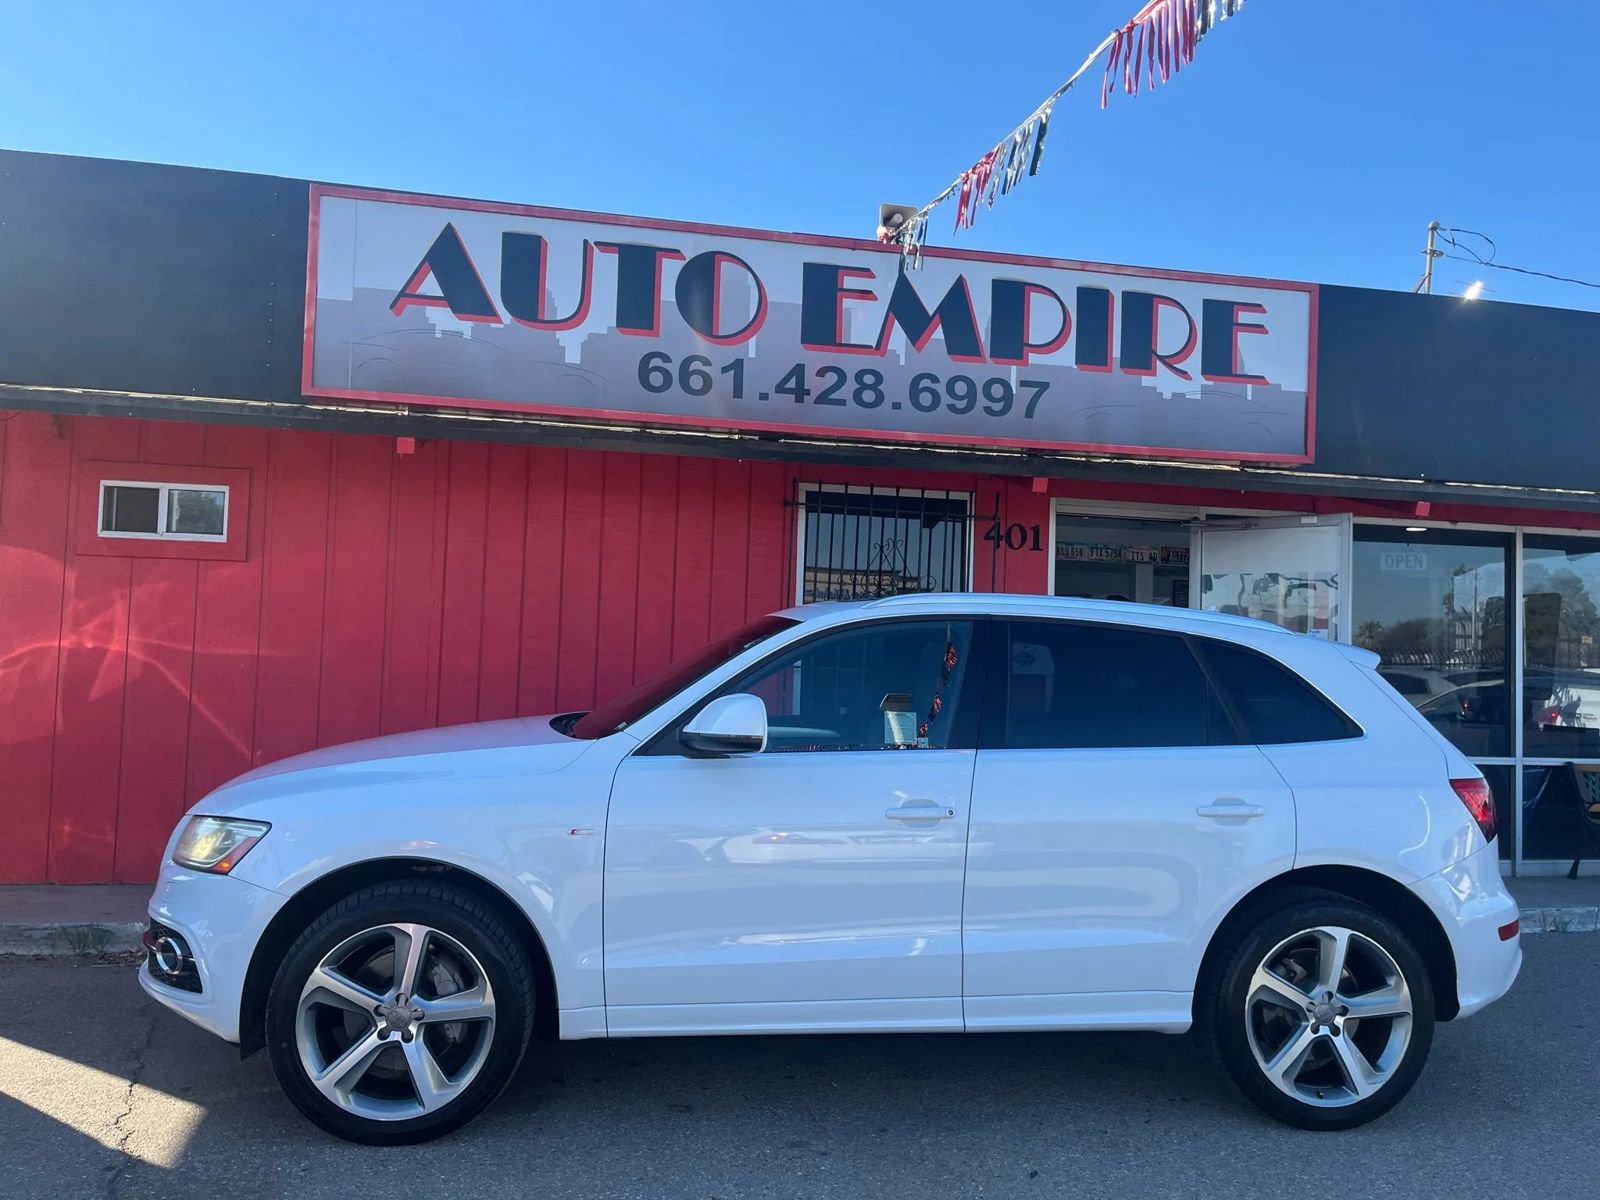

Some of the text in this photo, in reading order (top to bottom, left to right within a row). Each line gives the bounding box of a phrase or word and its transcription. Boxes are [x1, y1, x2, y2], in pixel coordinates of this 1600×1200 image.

[389, 222, 1270, 386] AUTO EMPIRE
[638, 351, 1051, 419] 661.428.6997
[983, 523, 1044, 552] 401
[1384, 553, 1424, 569] OPEN
